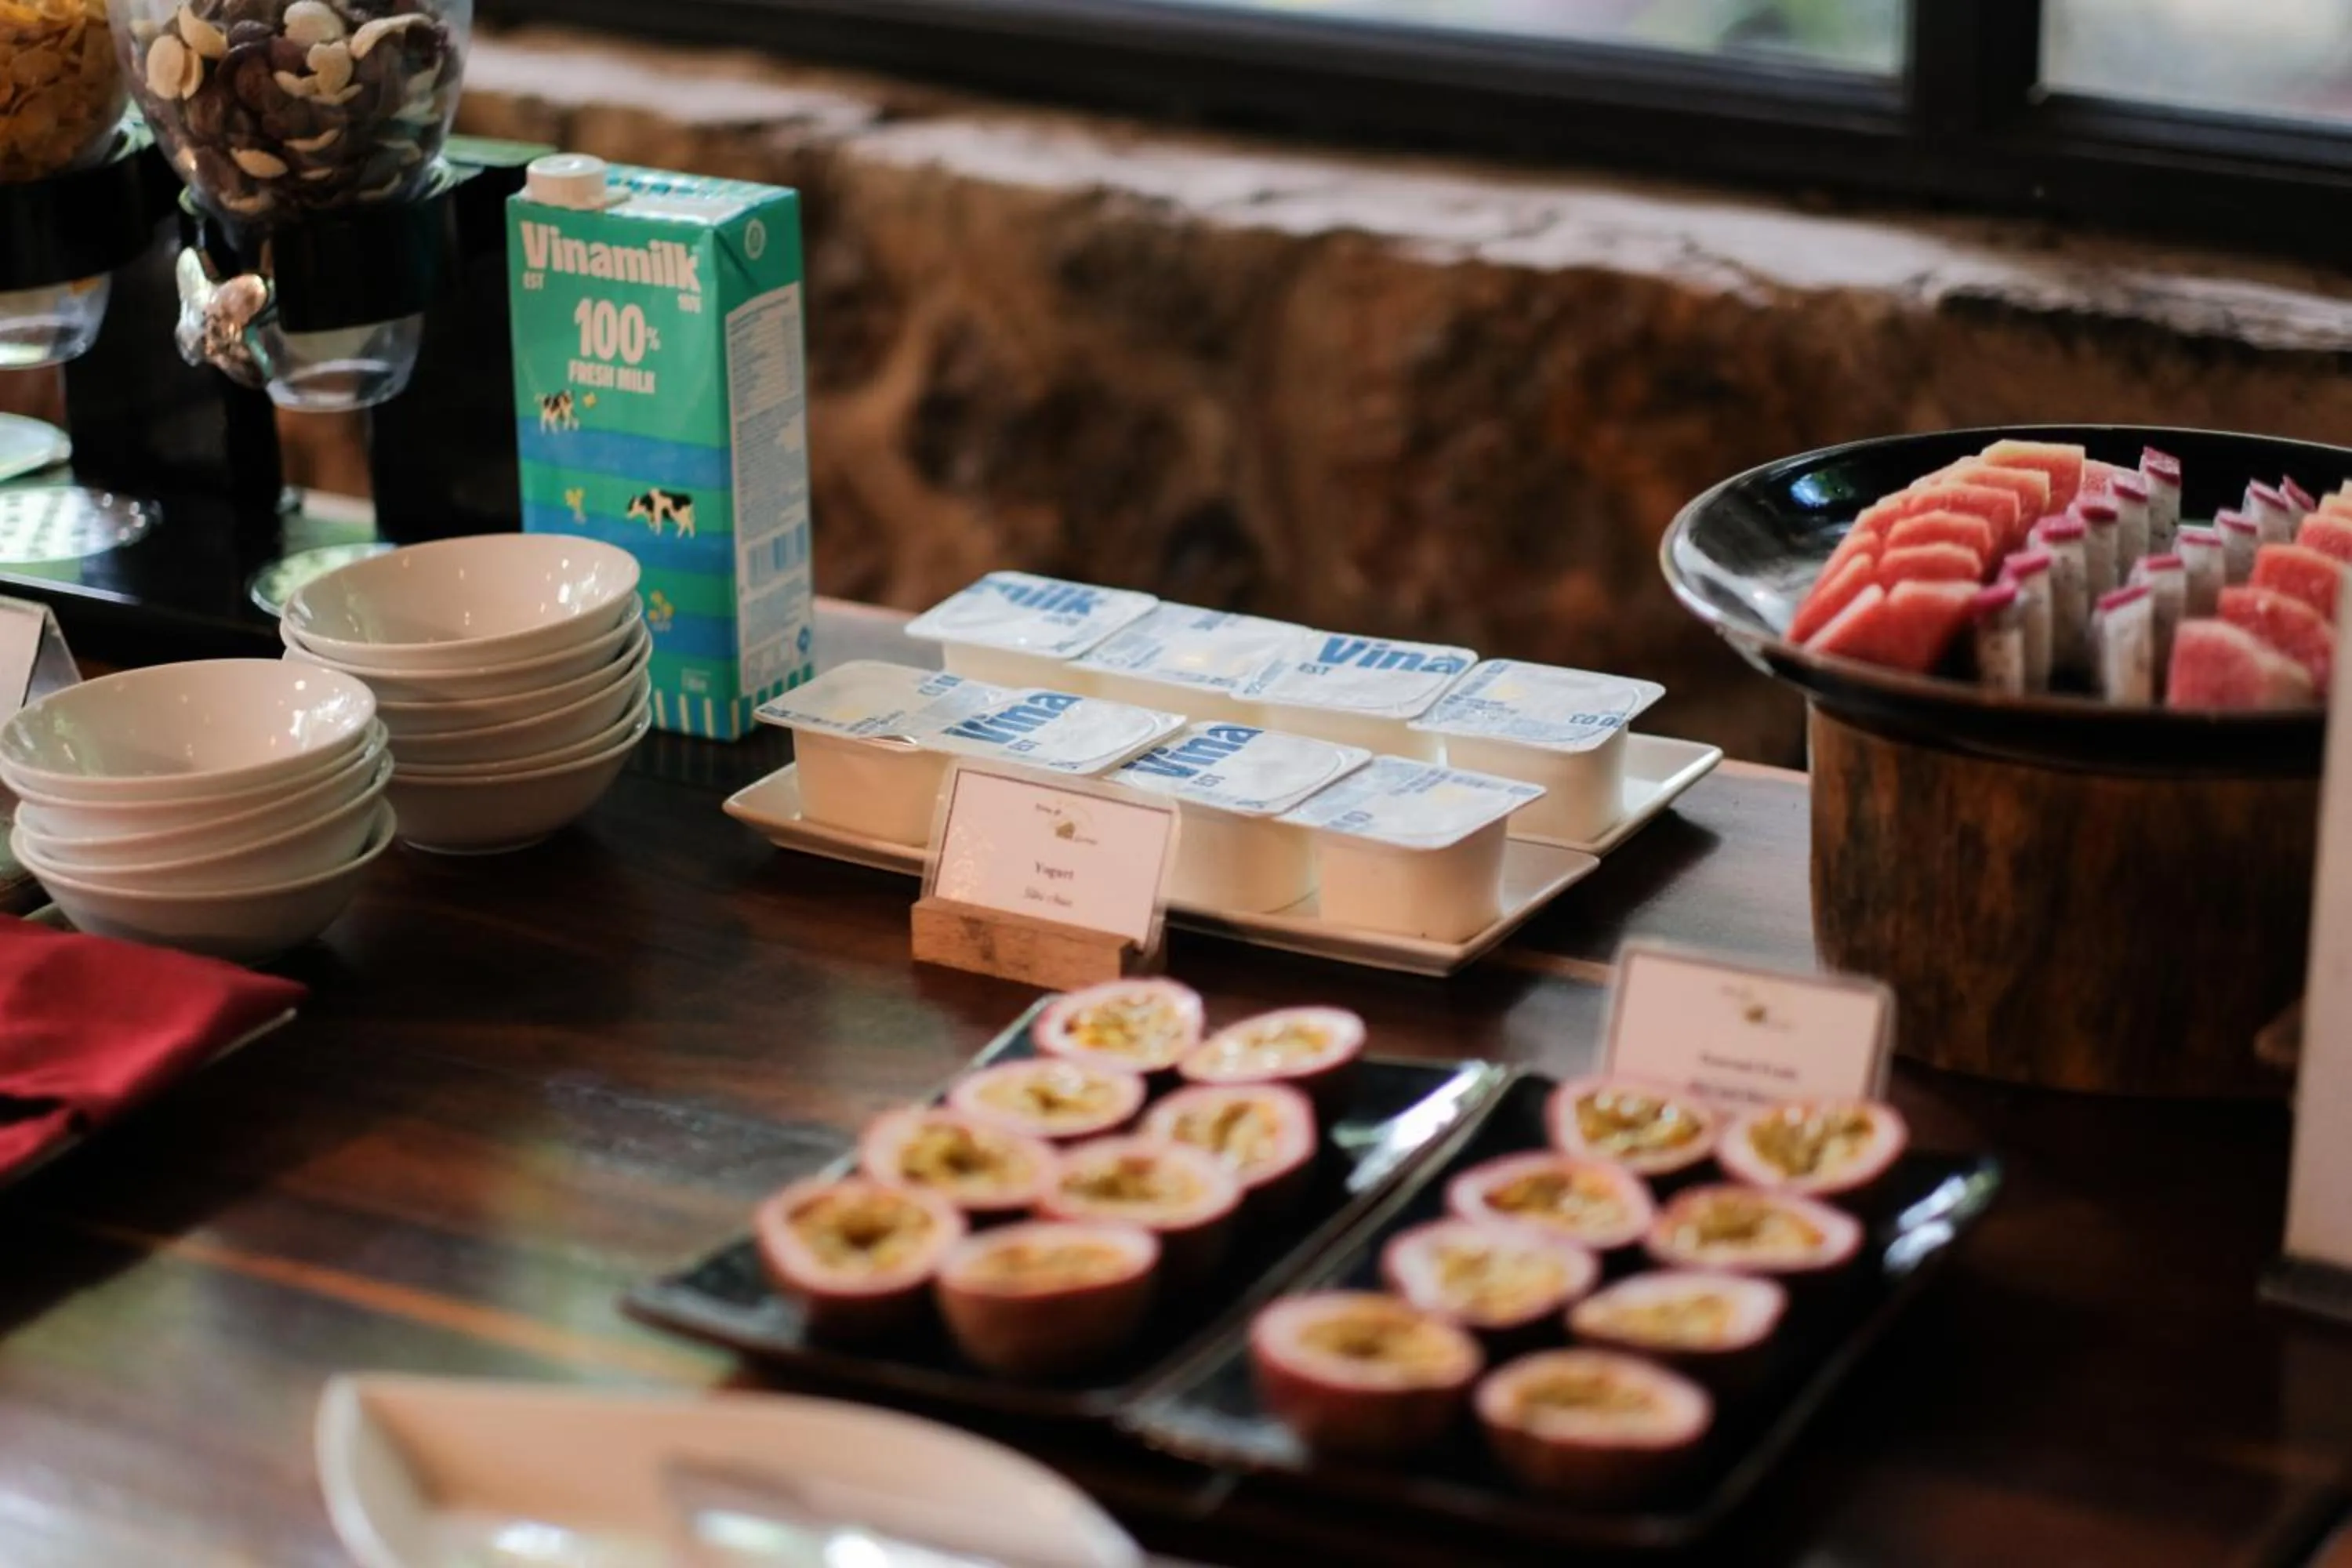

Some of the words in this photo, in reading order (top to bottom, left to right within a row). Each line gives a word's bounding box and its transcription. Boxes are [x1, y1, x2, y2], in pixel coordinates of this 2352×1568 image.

[520, 220, 701, 292] Vinamilk
[574, 297, 662, 365] 100%
[616, 367, 655, 394] MILK
[1298, 662, 1330, 676] EST
[1317, 636, 1469, 676] Vina
[942, 691, 1083, 744] Vina
[1120, 724, 1265, 778] Vina
